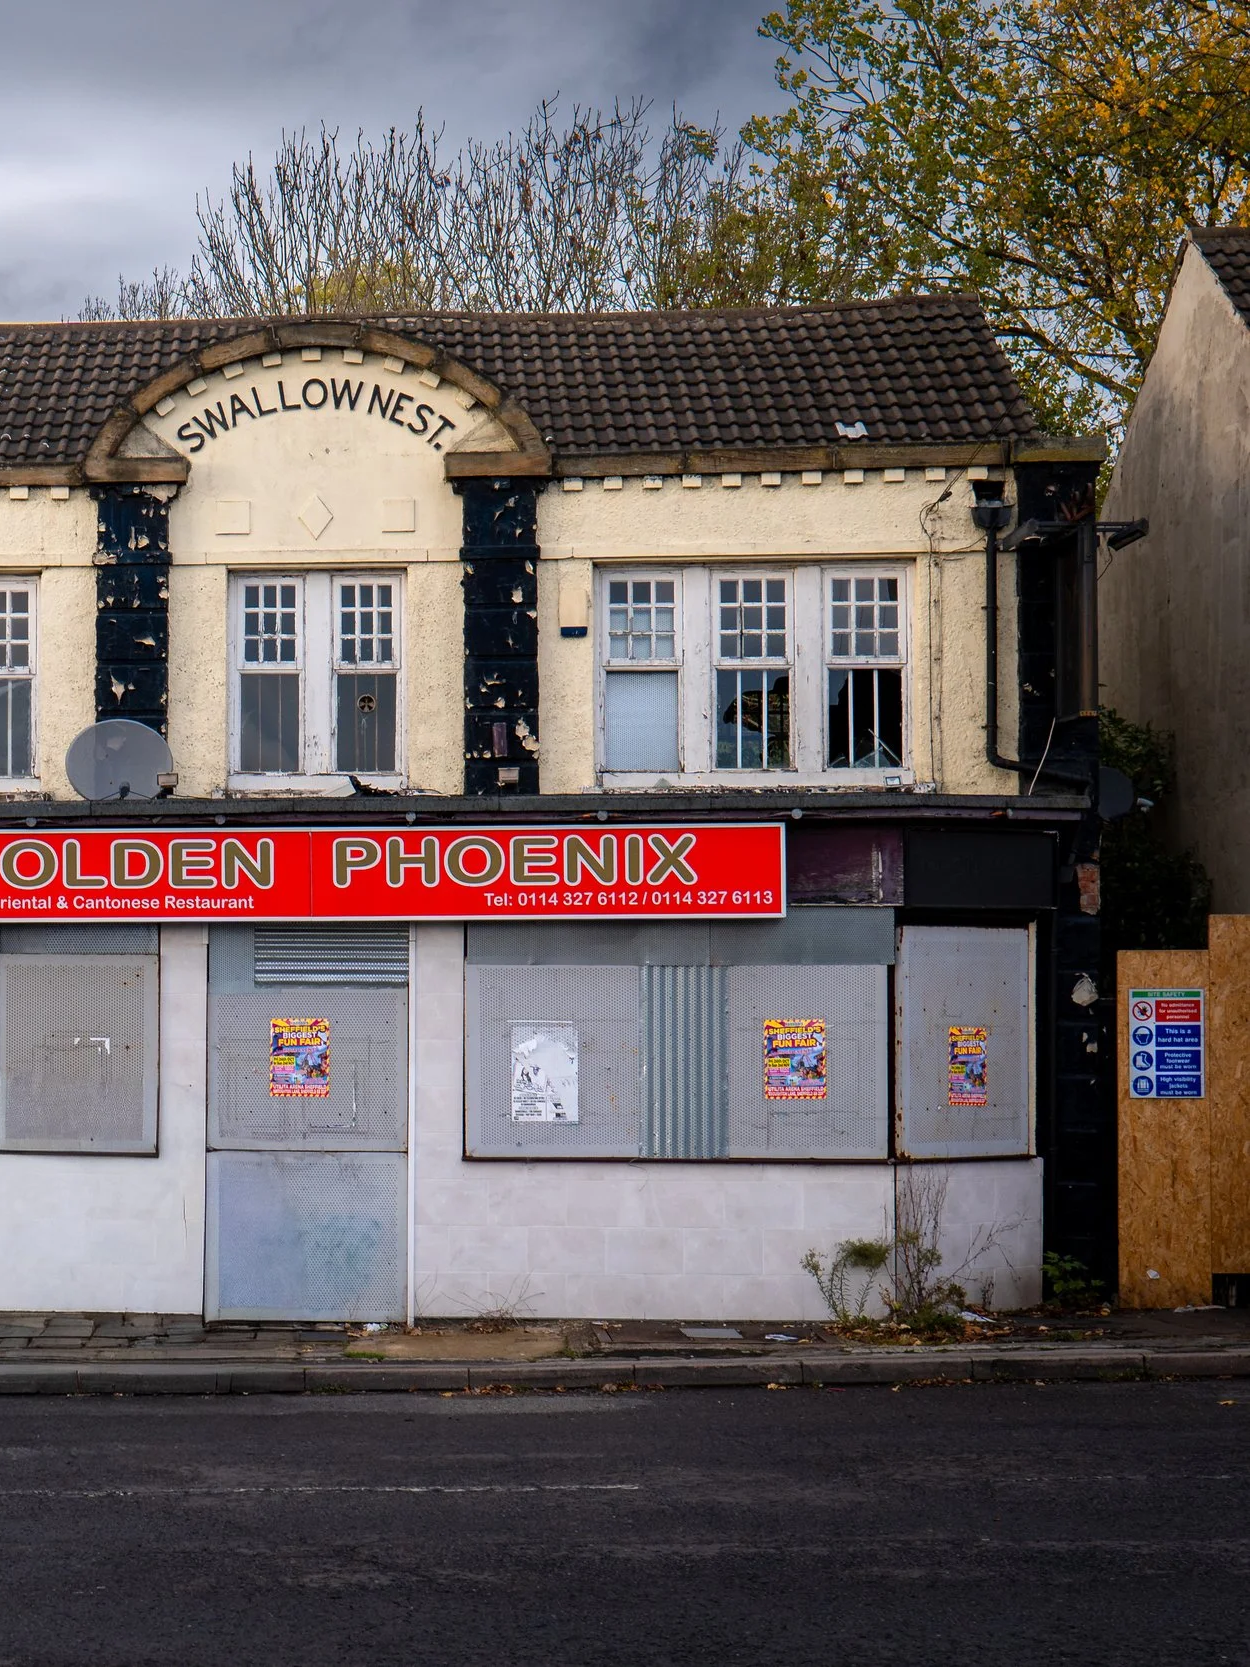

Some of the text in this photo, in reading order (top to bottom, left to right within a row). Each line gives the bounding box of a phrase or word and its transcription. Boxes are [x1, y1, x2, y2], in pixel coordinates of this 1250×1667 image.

[332, 833, 698, 889] PHOENIX
[56, 895, 69, 910] &
[72, 895, 160, 910] Cantonese
[164, 895, 255, 910] Restaurant
[483, 890, 773, 907] Tel: 0114 327 6112 / 0114 327 6113
[275, 1025, 326, 1033] SHEFFIELD'S
[278, 1038, 321, 1046] FUN FAIR
[794, 1039, 816, 1047] FAIR
[954, 1046, 982, 1055] FUN FAIR
